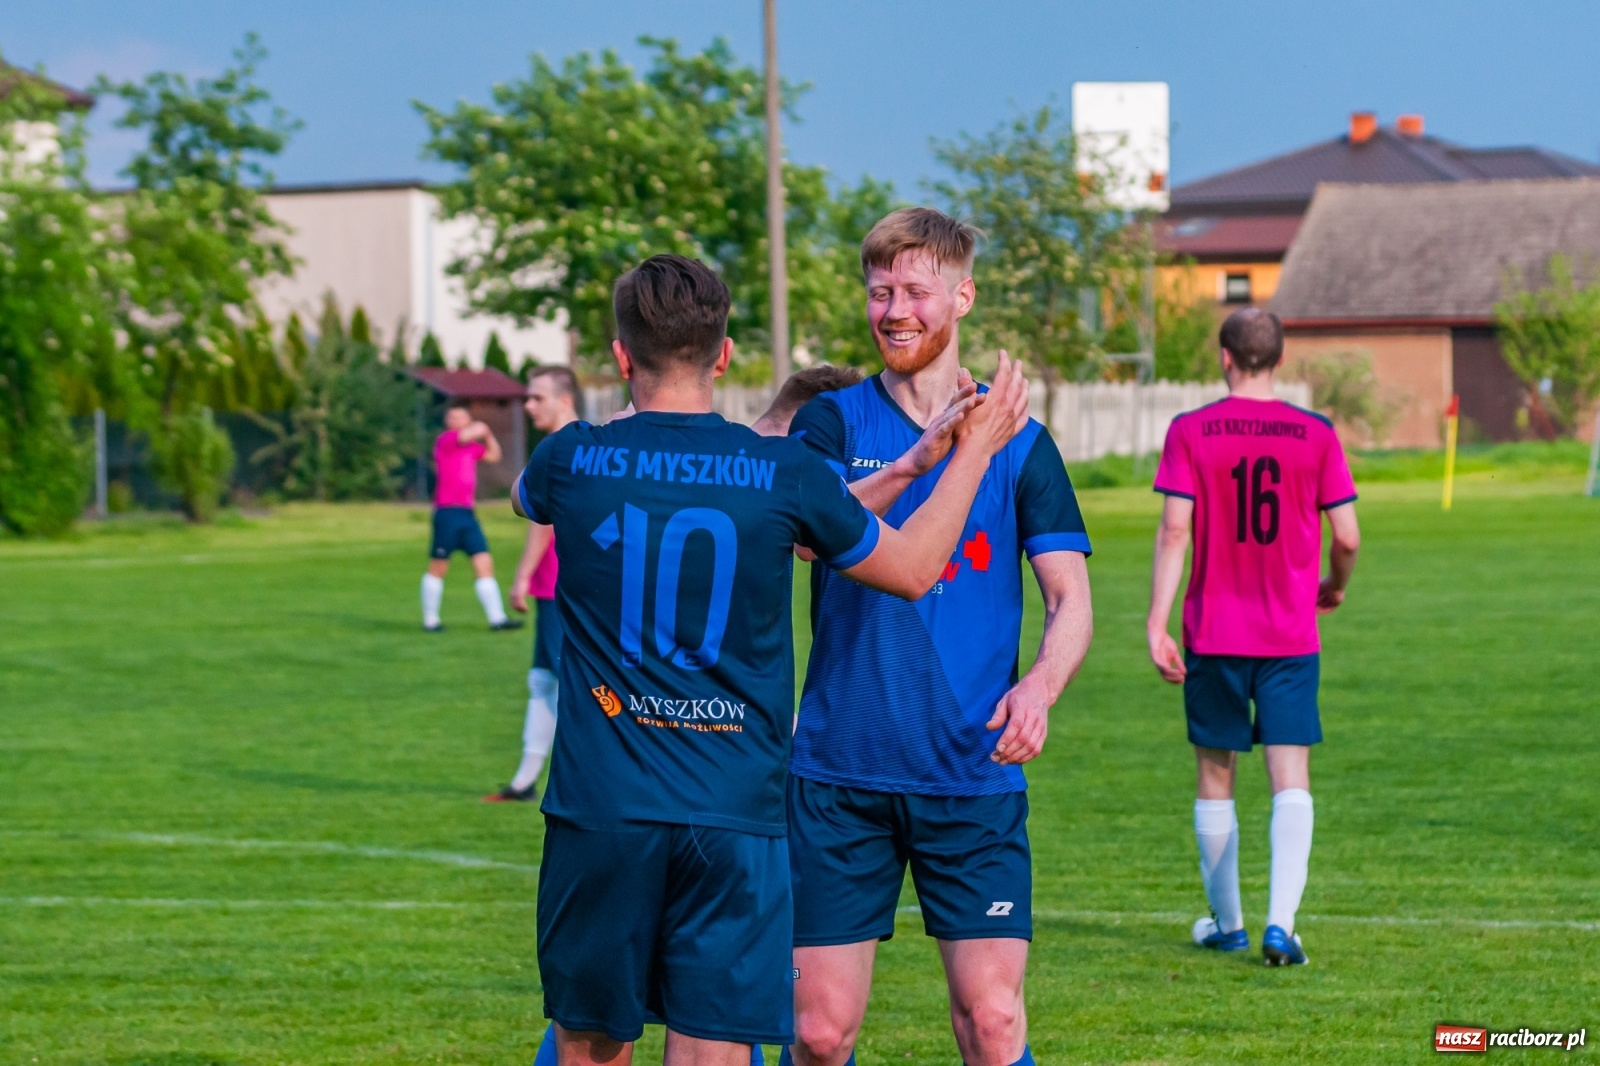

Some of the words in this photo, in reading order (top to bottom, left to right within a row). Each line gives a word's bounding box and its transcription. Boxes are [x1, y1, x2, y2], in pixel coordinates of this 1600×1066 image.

[1202, 419, 1222, 437] LKS
[571, 445, 629, 478] MKS
[635, 448, 776, 491] MYSZKÓW
[1231, 455, 1281, 546] 16
[590, 502, 738, 671] 10
[629, 694, 746, 720] MYSZKÓW
